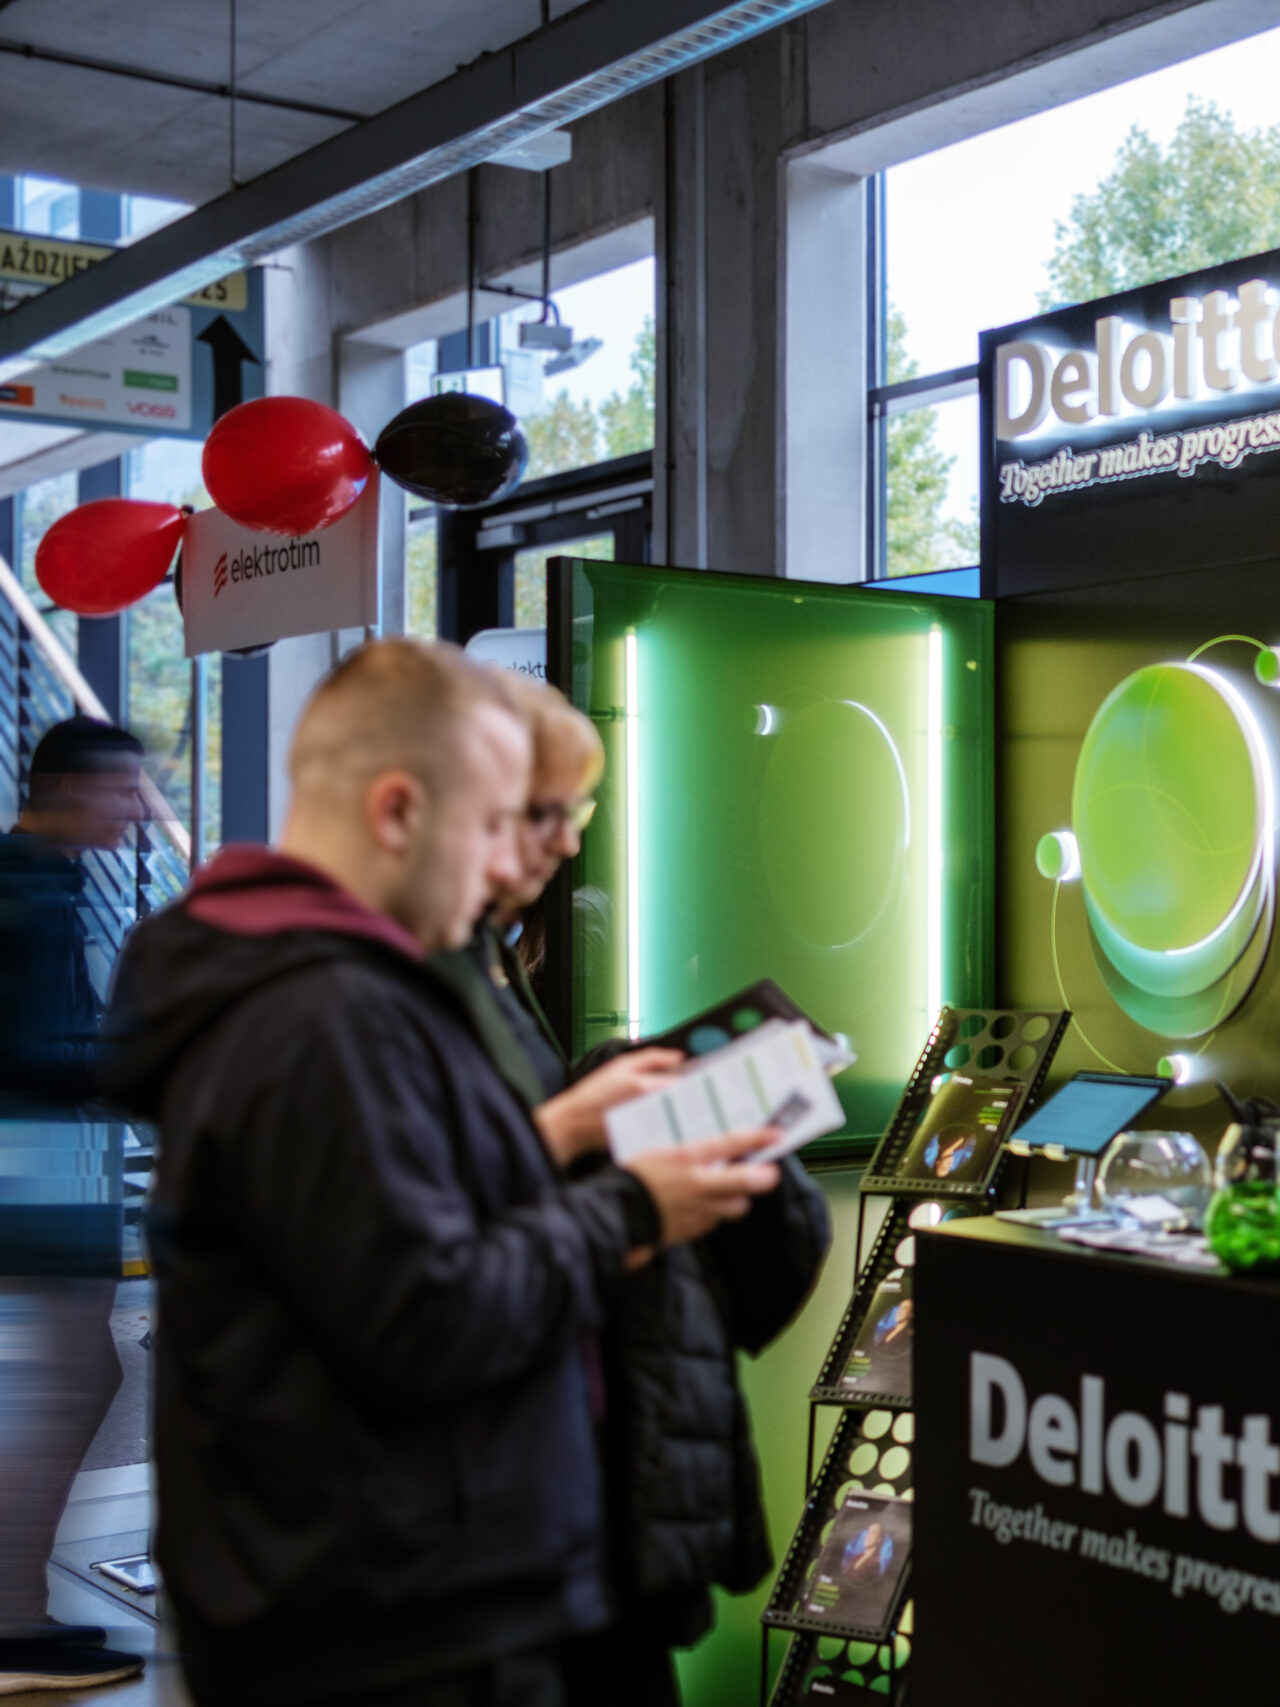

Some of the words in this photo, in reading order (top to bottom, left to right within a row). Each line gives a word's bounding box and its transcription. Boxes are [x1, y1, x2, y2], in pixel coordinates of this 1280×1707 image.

[2, 241, 98, 280] AŹDZIE
[1001, 446, 1097, 502] Together
[1098, 431, 1179, 477] makes
[230, 536, 321, 584] elektrotim
[969, 1488, 1077, 1552] Together
[1080, 1529, 1170, 1581] makes
